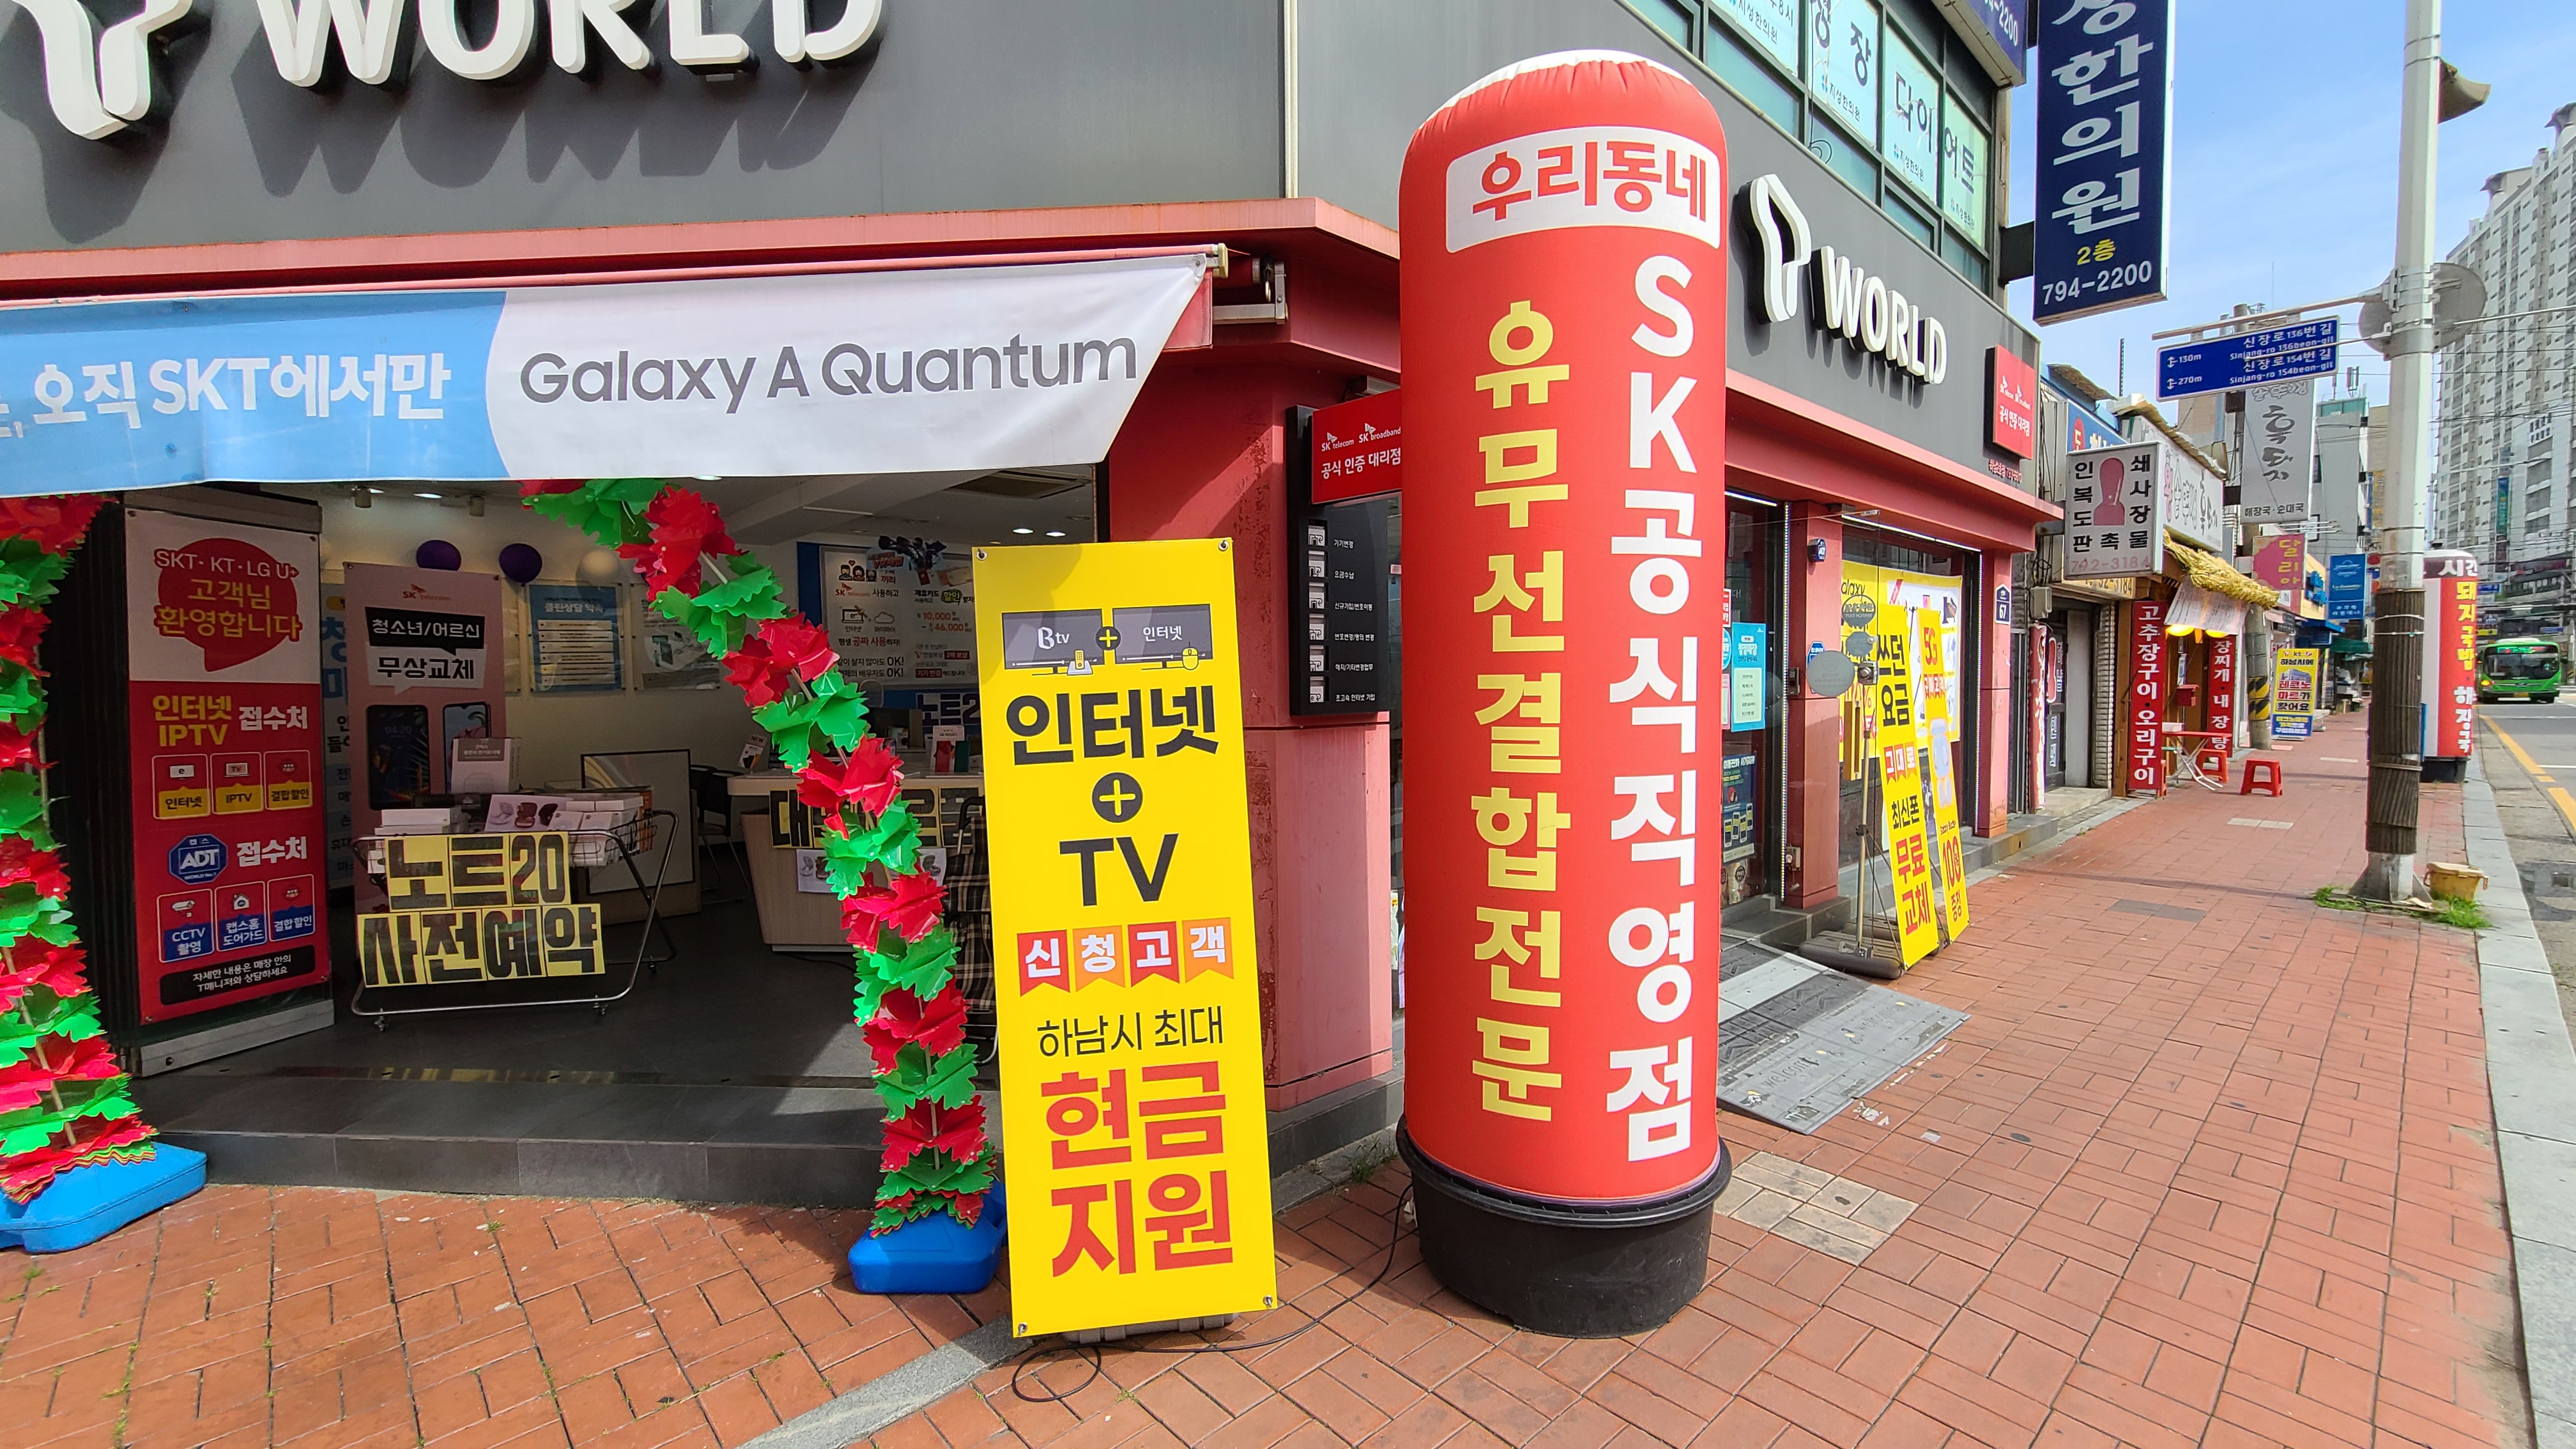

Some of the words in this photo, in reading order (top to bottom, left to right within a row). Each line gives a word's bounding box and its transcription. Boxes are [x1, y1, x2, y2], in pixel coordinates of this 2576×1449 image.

[1829, 82, 1860, 121] 지성한의원
[1895, 71, 1974, 194] 다이어트
[1472, 141, 1706, 222] 우리동네
[2076, 238, 2116, 266] 2층
[2043, 260, 2152, 305] 794-2200
[1821, 245, 1947, 385] WORLD
[2179, 353, 2202, 363] 130m
[520, 351, 757, 415] Galaxy
[766, 346, 810, 399] A
[822, 332, 1137, 396] Quantum
[2178, 375, 2202, 385] 270m
[2230, 371, 2276, 384] Sinjang-ro
[2278, 361, 2334, 377] 154beon-gil
[33, 361, 142, 429] 오직
[150, 353, 452, 420] SKT에서만
[1321, 441, 1331, 452] SK
[1333, 439, 1354, 449] telecom
[1358, 433, 1368, 443] SK
[1370, 427, 1401, 440] broadband
[1321, 459, 1341, 480] 공식
[1344, 454, 1365, 475] 인증
[1368, 447, 1401, 467] 대리점
[2075, 454, 2151, 480] 인쇄
[2073, 479, 2152, 503] 복사
[2072, 505, 2151, 528] 도장
[1333, 539, 1354, 549] 기기변경
[2072, 530, 2149, 553] 판촉물
[247, 562, 271, 578] LG
[277, 564, 300, 578] U+
[2071, 555, 2151, 573] 792-3184
[187, 578, 271, 611] 고객님
[402, 590, 417, 599] SK
[872, 589, 900, 597] 사용하고
[157, 606, 303, 640] 환영합니다
[1999, 604, 2007, 620] 67
[371, 618, 480, 638] 청소년/어르신
[1142, 625, 1183, 642] 인터넷
[852, 637, 869, 647] 공짜
[1923, 627, 1938, 666] 5G
[377, 657, 475, 680] 무상교체
[887, 656, 904, 666] OK!
[1877, 634, 1906, 677] 쓰던
[887, 668, 904, 678] OK!
[152, 695, 232, 721] 인터넷
[1351, 694, 1365, 702] 인터넷
[1471, 300, 1570, 1122] 유무선결합전문
[1606, 256, 1703, 1162] SK공식직영점
[1881, 683, 1910, 727] 요금
[238, 705, 308, 731] 접수처
[1006, 685, 1219, 766] 인터넷
[158, 724, 228, 747] IPTV
[750, 735, 765, 743] NEW
[1885, 746, 1916, 774] 그대로
[165, 796, 203, 809] 인터넷
[225, 792, 253, 804] IPTV
[1891, 794, 1920, 829] 최신폰
[180, 848, 220, 870] ADT
[236, 836, 307, 868] 접수처
[1896, 833, 1926, 884] 무료
[388, 834, 566, 910] 노트20
[1059, 832, 1179, 907] TV
[1901, 881, 1931, 936] 교체
[171, 927, 206, 942] CCTV
[222, 930, 264, 946] 도어가드
[363, 906, 598, 986] 사전예약
[177, 940, 202, 956] 촬영
[1025, 925, 1226, 979] 신청고객
[192, 969, 222, 981] 자세한
[224, 963, 252, 976] 내용은
[253, 958, 273, 969] 매장
[197, 977, 242, 992] T매니저와
[243, 965, 288, 983] 상담하세요
[1037, 1011, 1143, 1058] 하남시
[1154, 1005, 1224, 1048] 최대
[1040, 1060, 1227, 1170] 현금
[1050, 1169, 1234, 1278] 지원
